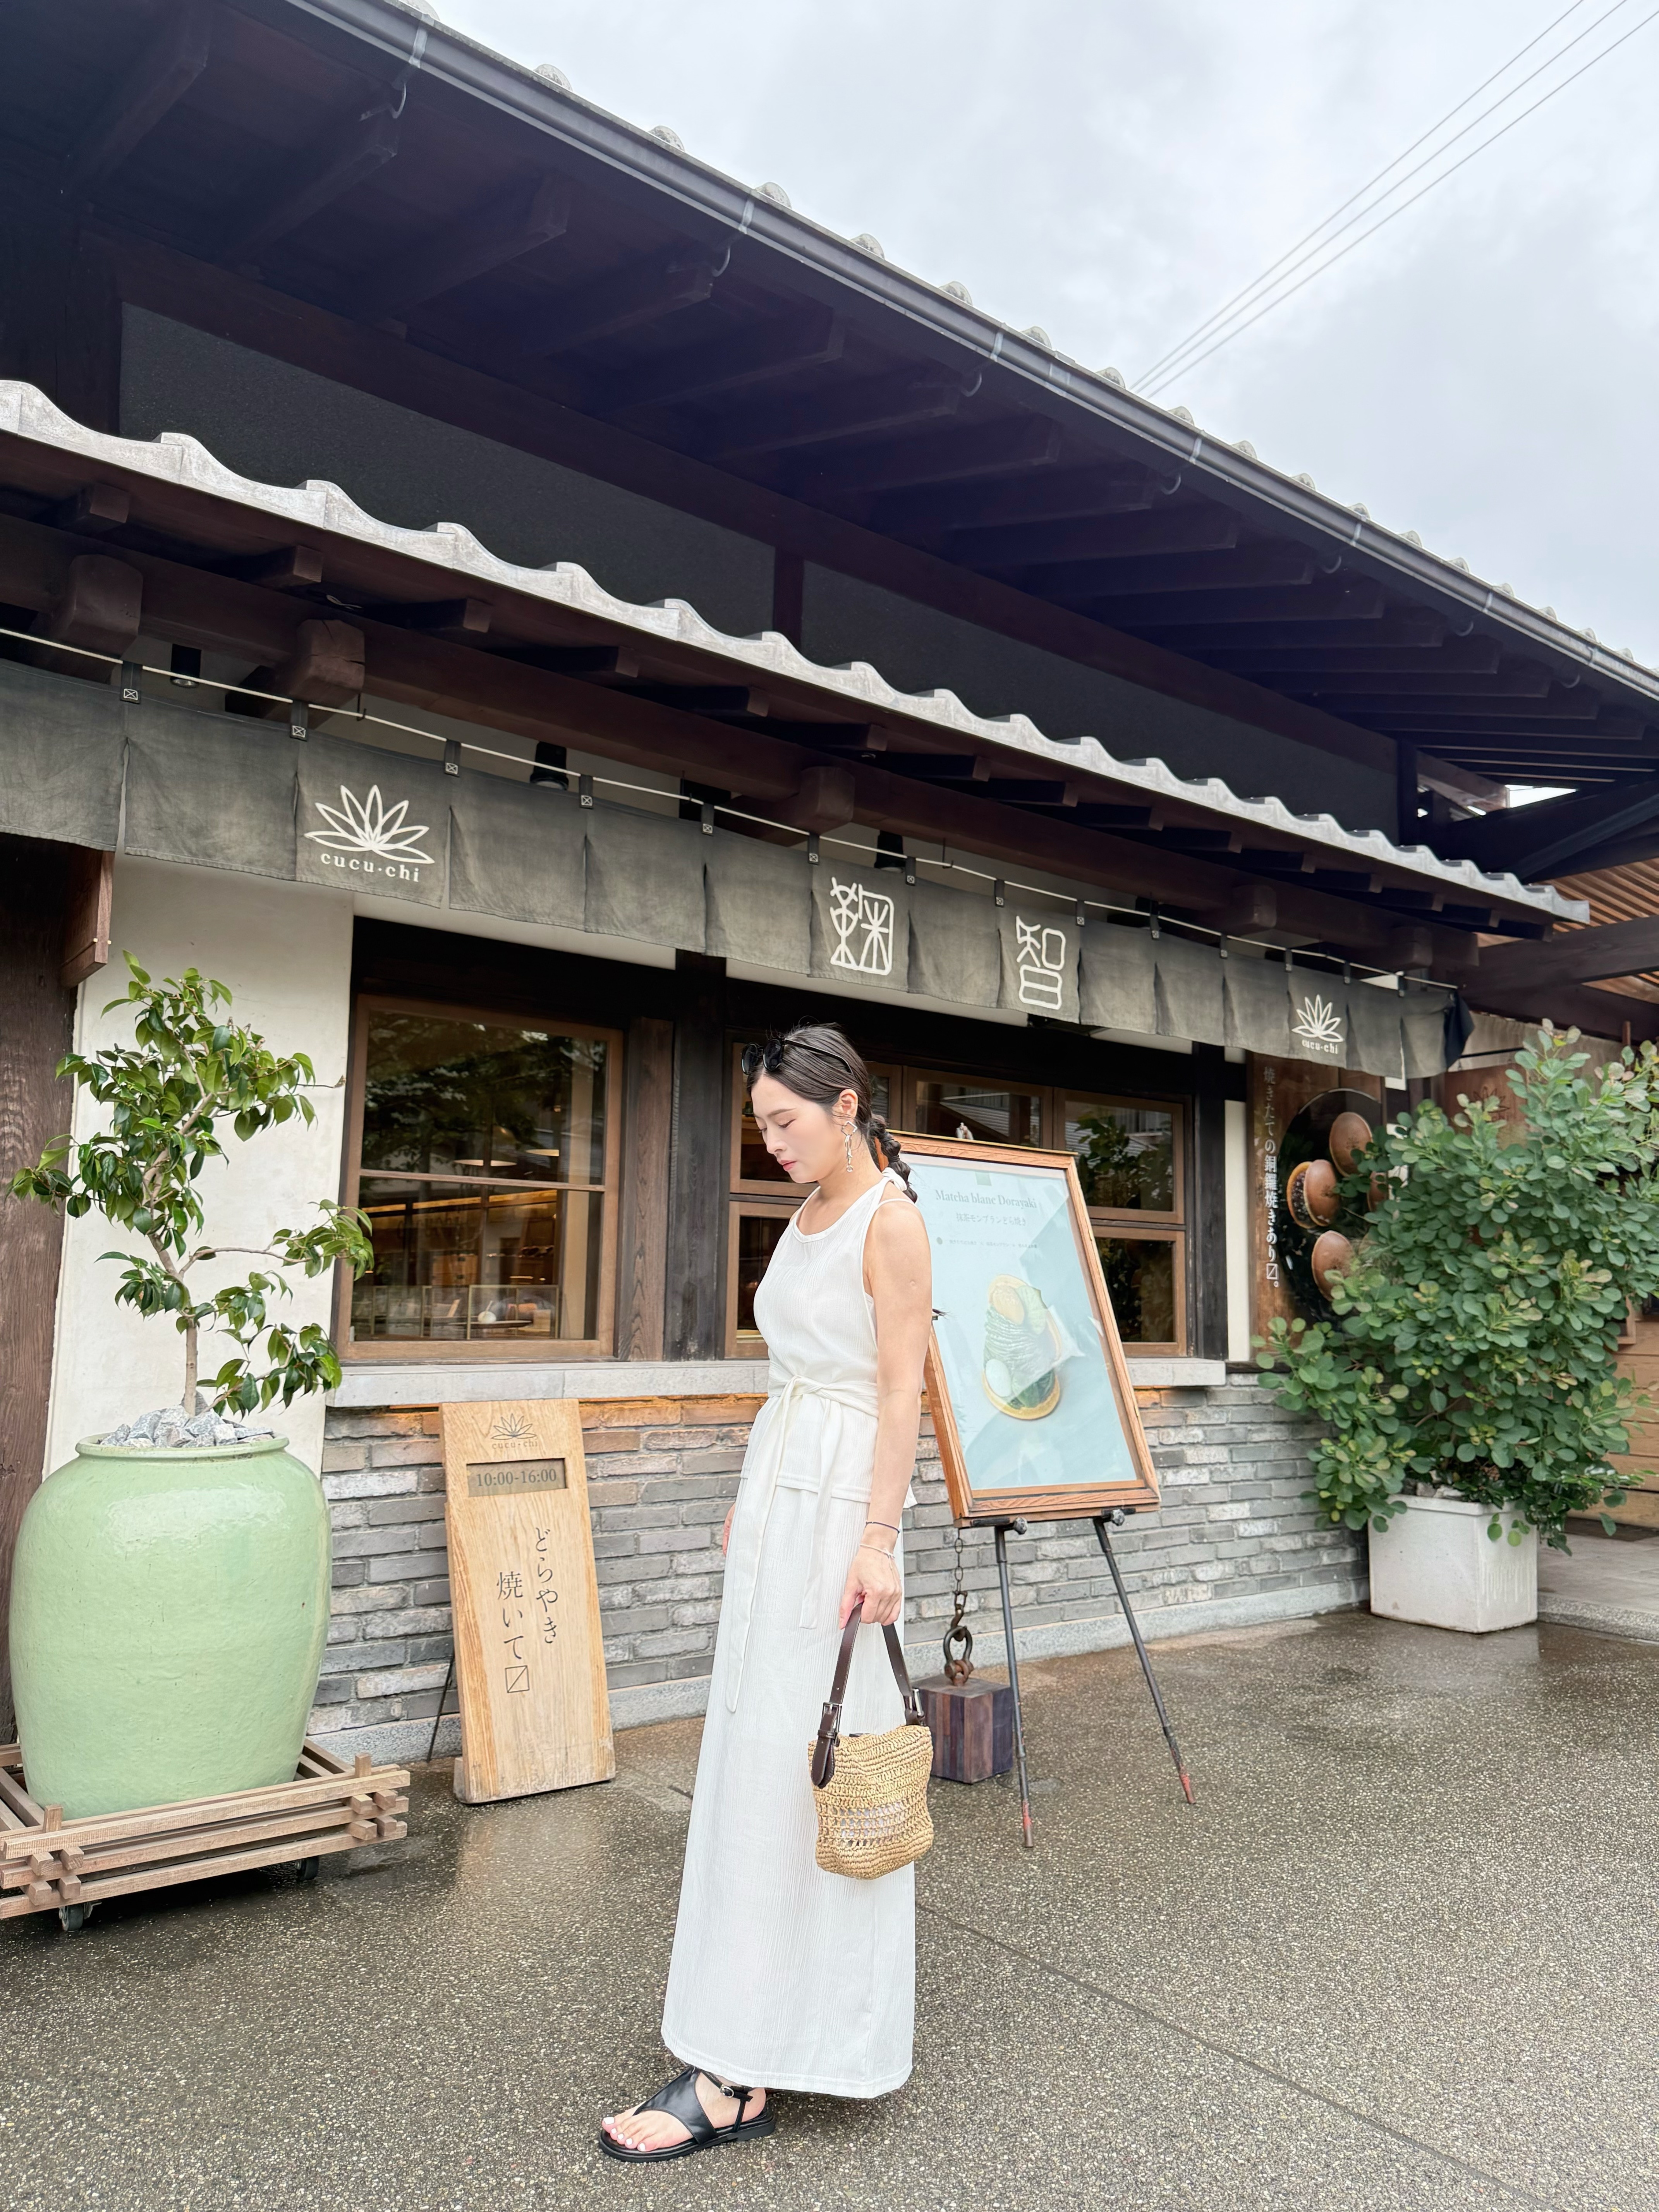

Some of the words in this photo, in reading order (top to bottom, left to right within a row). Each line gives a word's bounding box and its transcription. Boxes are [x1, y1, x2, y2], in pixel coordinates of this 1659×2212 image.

[935, 1189, 969, 1203] Matcha
[971, 1192, 996, 1205] blanc
[998, 1194, 1037, 1209] Dorayaki
[956, 1212, 1026, 1226] 抹茶モンブランどら焼き
[476, 1468, 557, 1487] 10:00-16:00
[536, 1527, 558, 1644] どらやき
